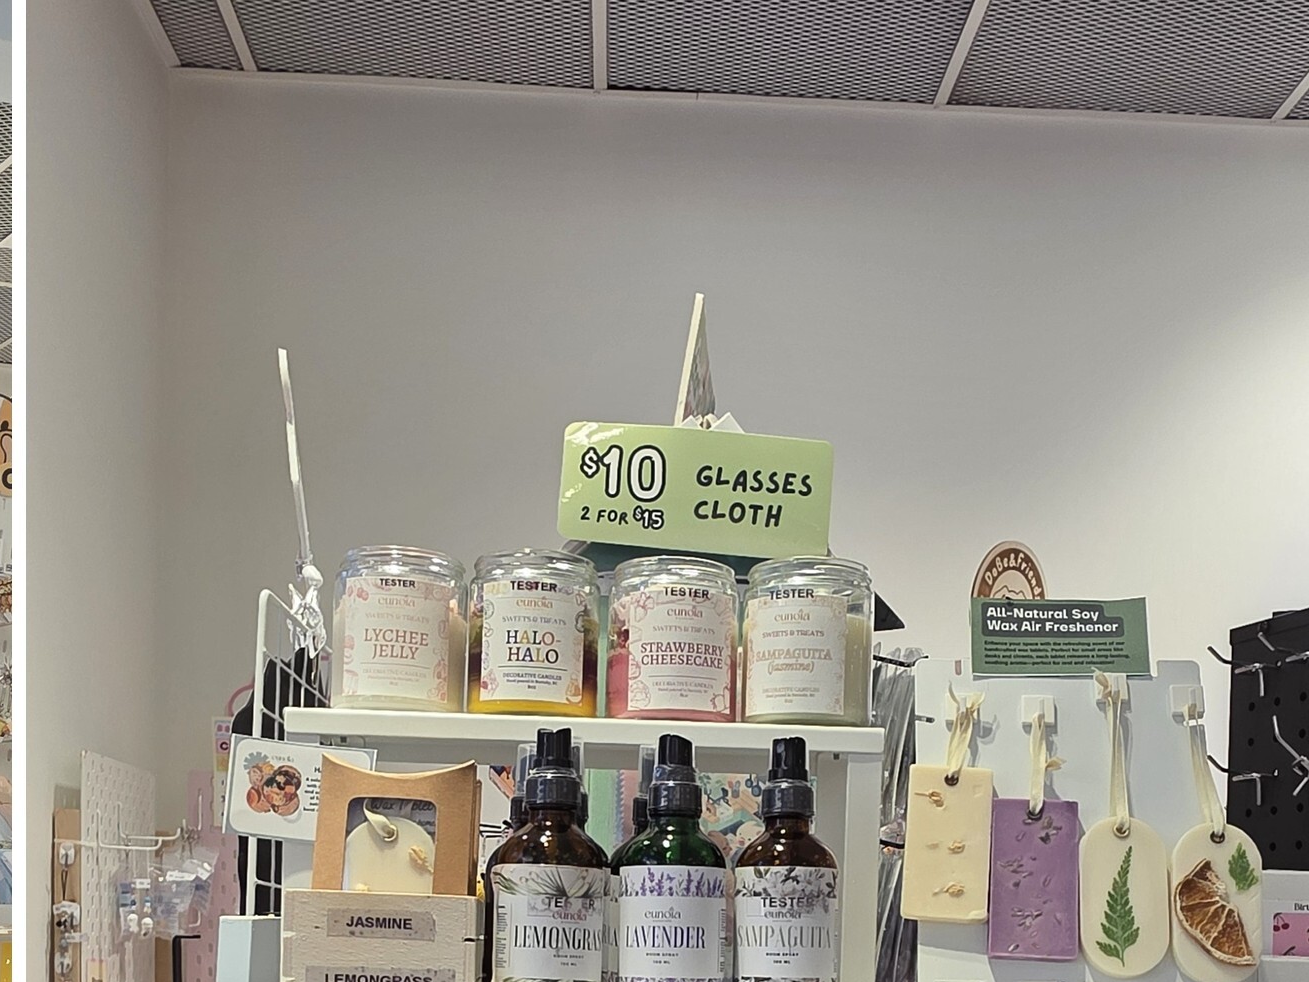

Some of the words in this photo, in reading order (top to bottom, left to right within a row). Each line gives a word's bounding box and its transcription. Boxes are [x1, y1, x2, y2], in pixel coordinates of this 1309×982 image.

[580, 444, 666, 502] $10
[696, 465, 812, 496] GLASSES
[580, 506, 591, 521] 2
[597, 509, 629, 525] FOR
[633, 505, 664, 530] $15
[694, 500, 783, 528] CLOTH
[379, 578, 416, 589] TESTER
[510, 580, 558, 593] TESTER
[663, 586, 710, 600] TESTER
[769, 589, 815, 600] TESTER
[987, 607, 1068, 620] All-Natural
[1072, 609, 1099, 622] Soy
[987, 620, 1018, 631] Wax
[1021, 621, 1041, 631] Air
[1045, 621, 1119, 632] Freshener
[364, 628, 429, 647] LYCHEE
[506, 630, 561, 646] HALO-
[372, 644, 420, 660] JELLY
[507, 647, 559, 664] HALO
[640, 642, 724, 657] STRAWBERRY
[756, 648, 833, 661] SAMPAGUITA
[641, 654, 723, 669] CHEESECAKE
[768, 660, 815, 674] (jasmine)
[346, 916, 413, 930] JASMINE
[626, 925, 706, 949] LAVENDER
